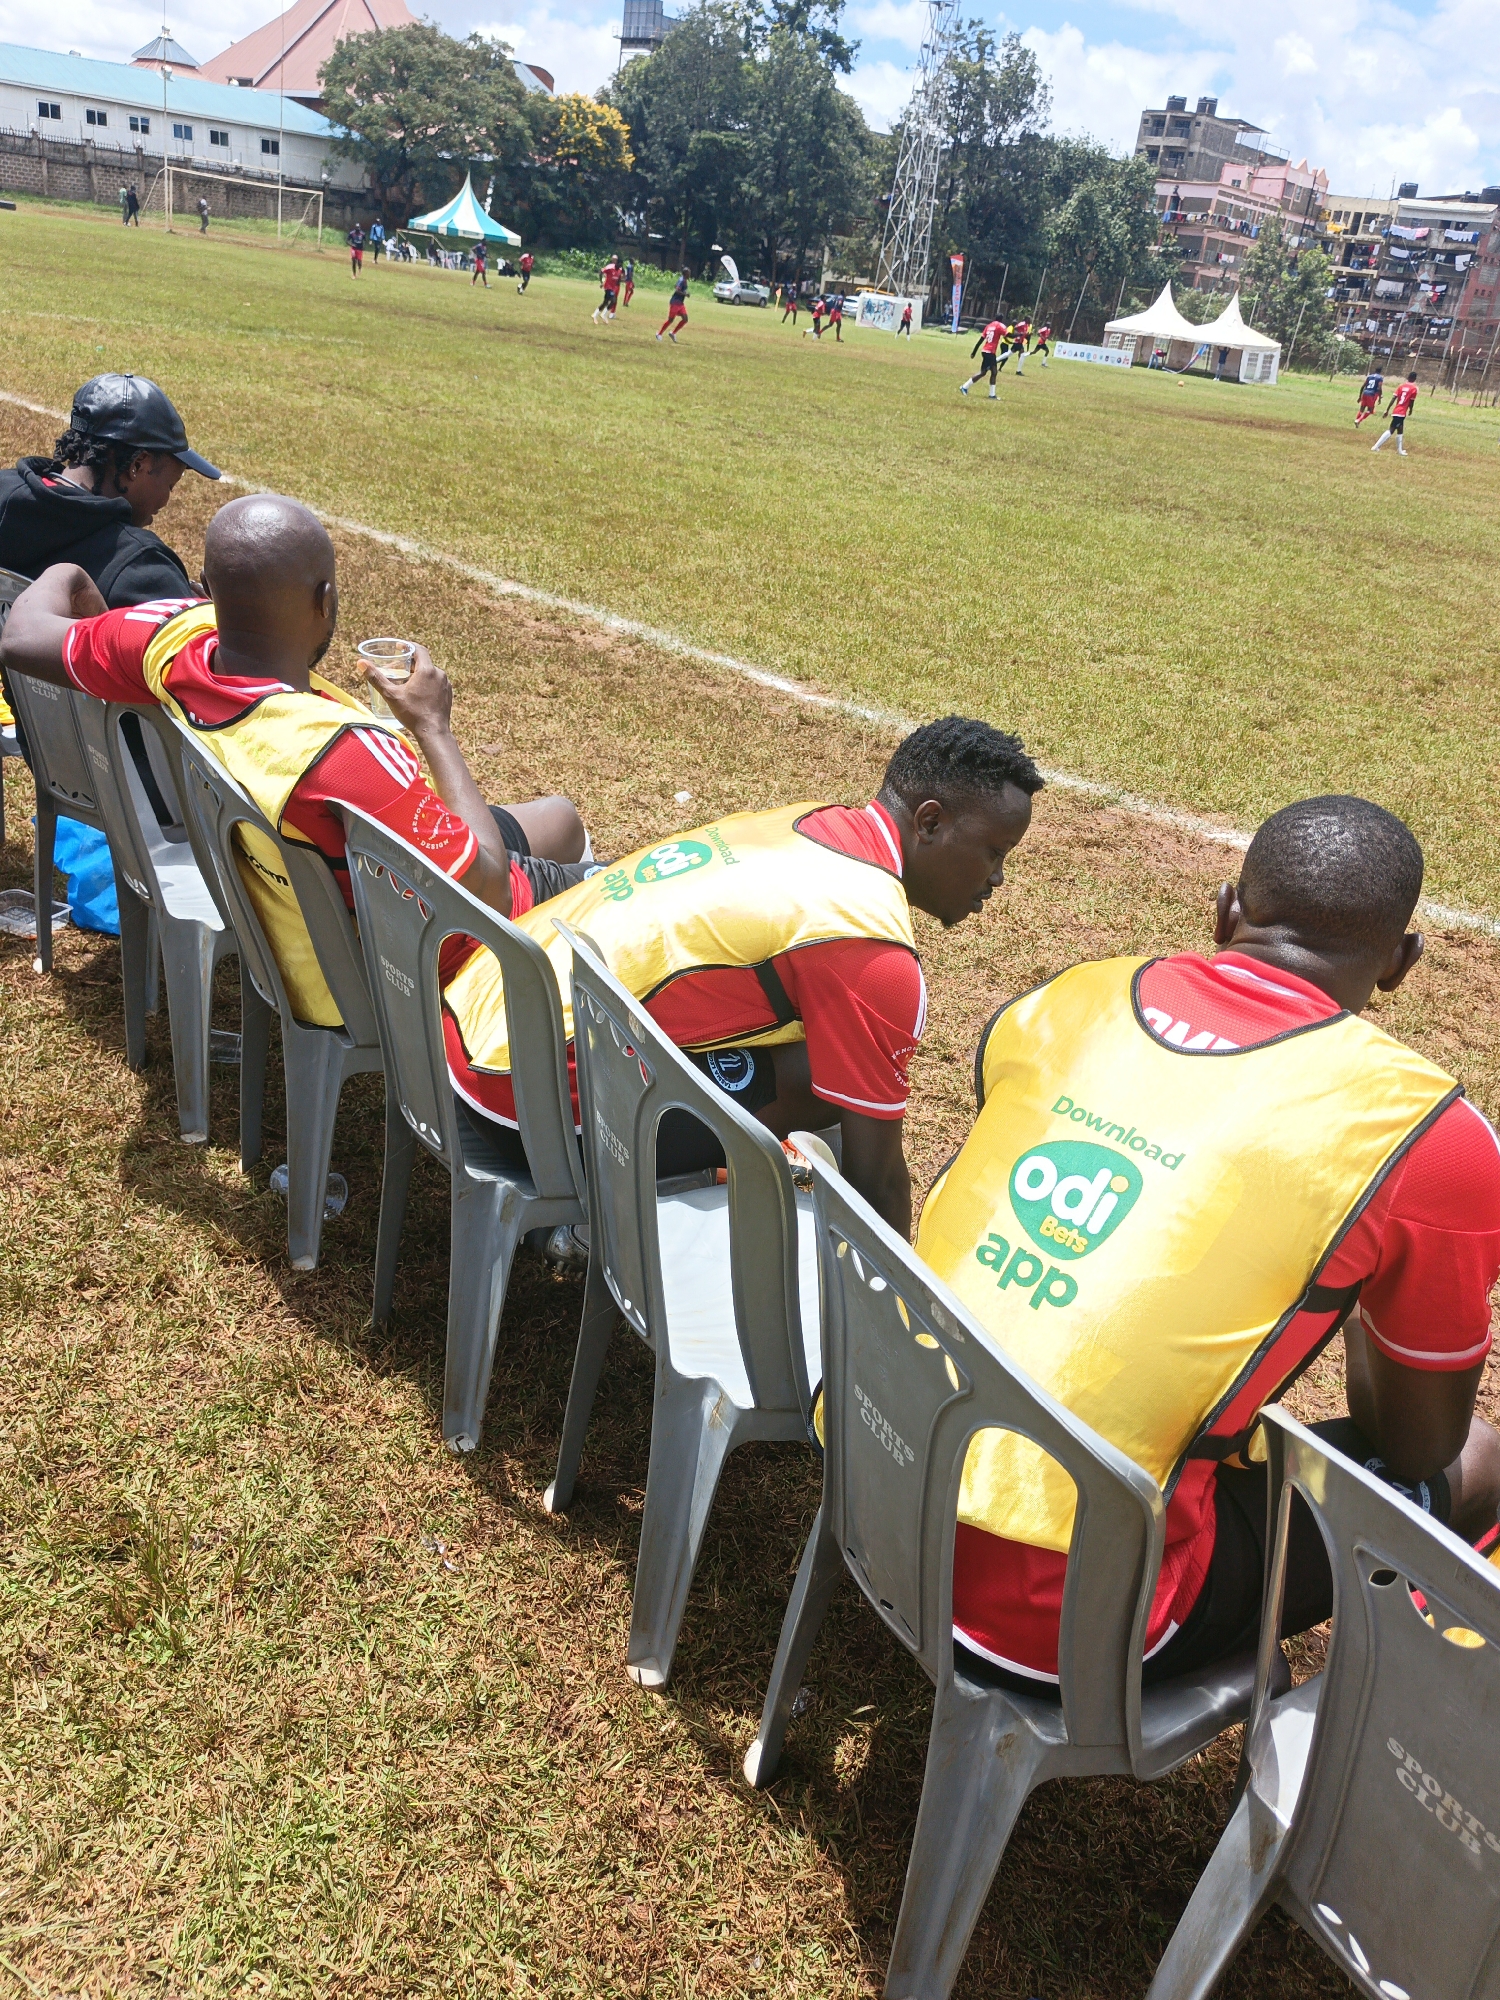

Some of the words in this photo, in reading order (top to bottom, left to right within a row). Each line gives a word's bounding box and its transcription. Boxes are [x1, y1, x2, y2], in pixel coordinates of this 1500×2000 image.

[31, 686, 58, 701] CLUB
[420, 838, 450, 850] DESIGN
[649, 843, 703, 876] odi
[704, 826, 741, 866] Download
[600, 869, 634, 902] app
[380, 954, 415, 989] SPORTS
[385, 969, 411, 997] CLUB
[596, 1110, 630, 1160] SPORTS
[600, 1129, 626, 1167] CLUB
[1050, 1095, 1187, 1171] Download
[1014, 1155, 1130, 1235] odi
[1038, 1214, 1089, 1255] Bets
[975, 1232, 1079, 1311] app
[854, 1384, 915, 1462] SPORTS
[860, 1407, 905, 1467] CLUB
[1386, 1737, 1500, 1853] SPORTS
[1395, 1767, 1481, 1855] CLUB
